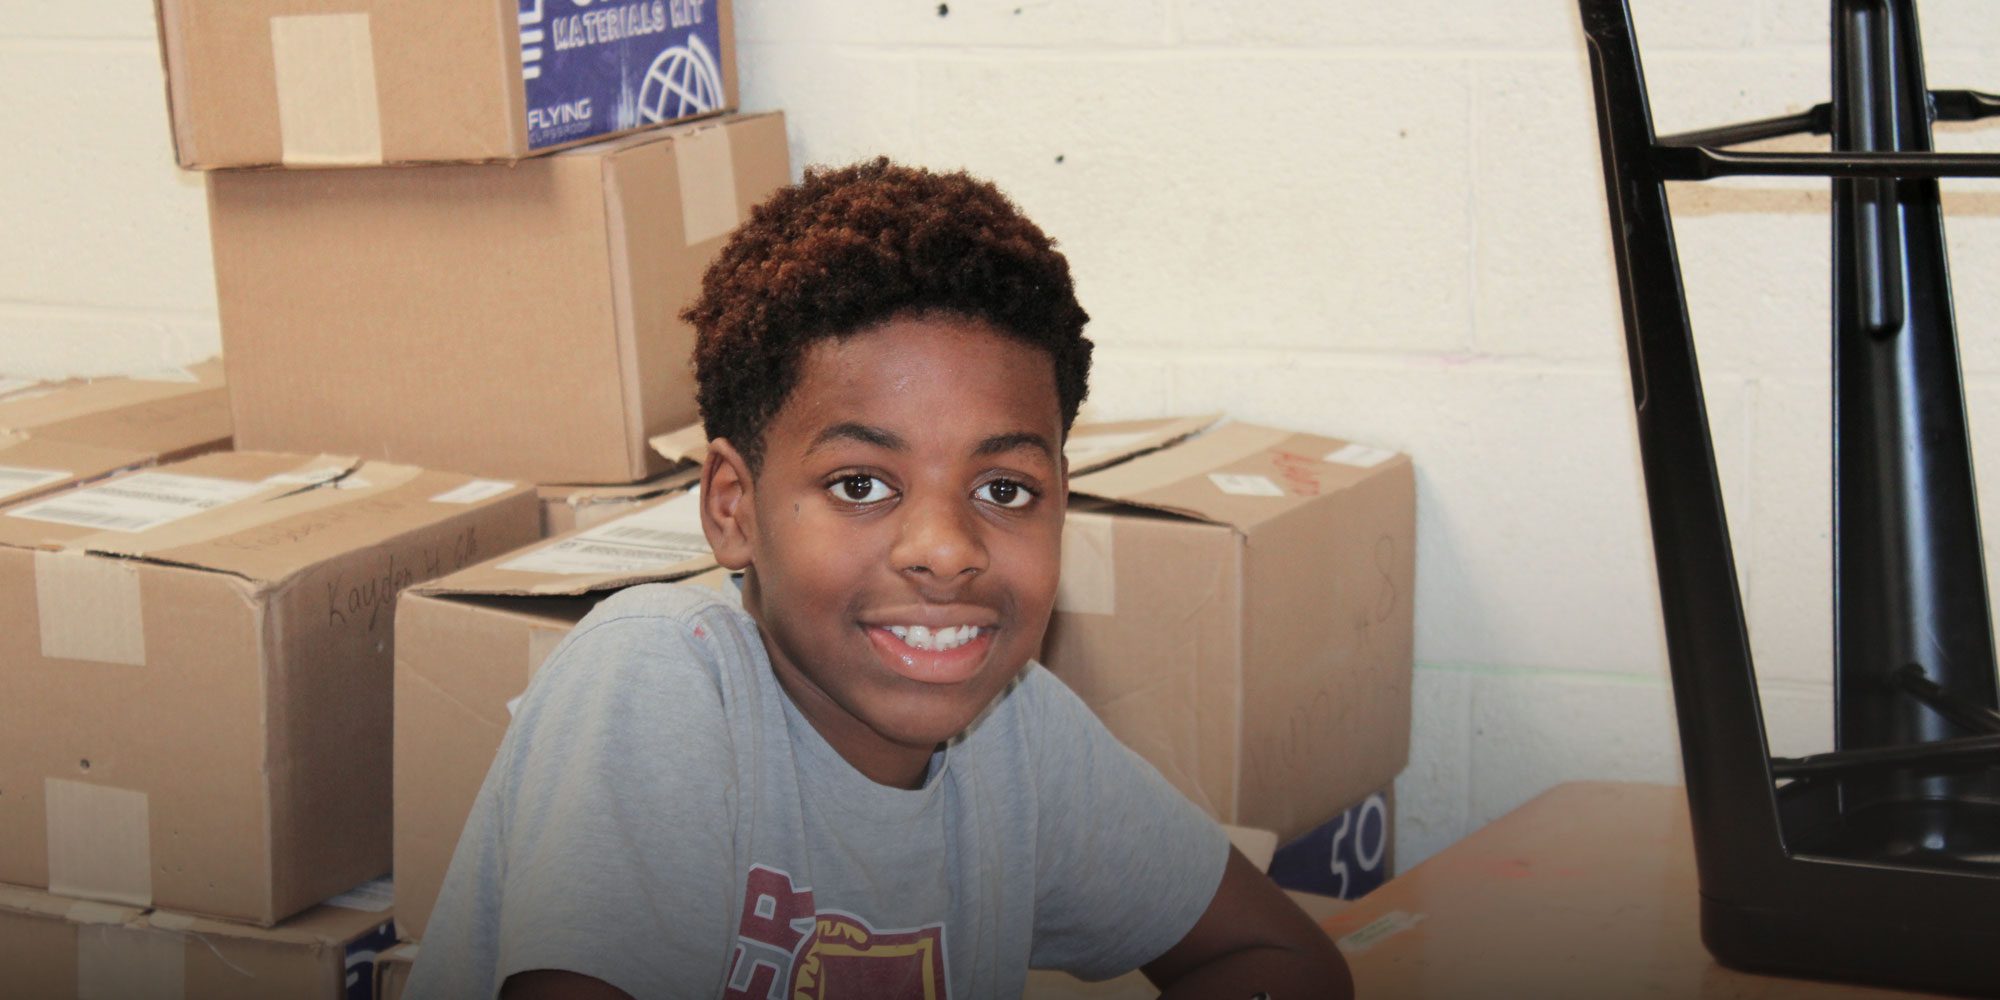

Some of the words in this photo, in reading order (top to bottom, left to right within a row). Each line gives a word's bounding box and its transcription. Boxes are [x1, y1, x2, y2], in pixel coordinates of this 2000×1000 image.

[552, 2, 666, 51] MATERIALS
[669, 0, 704, 28] KIT
[528, 98, 592, 131] FLYING
